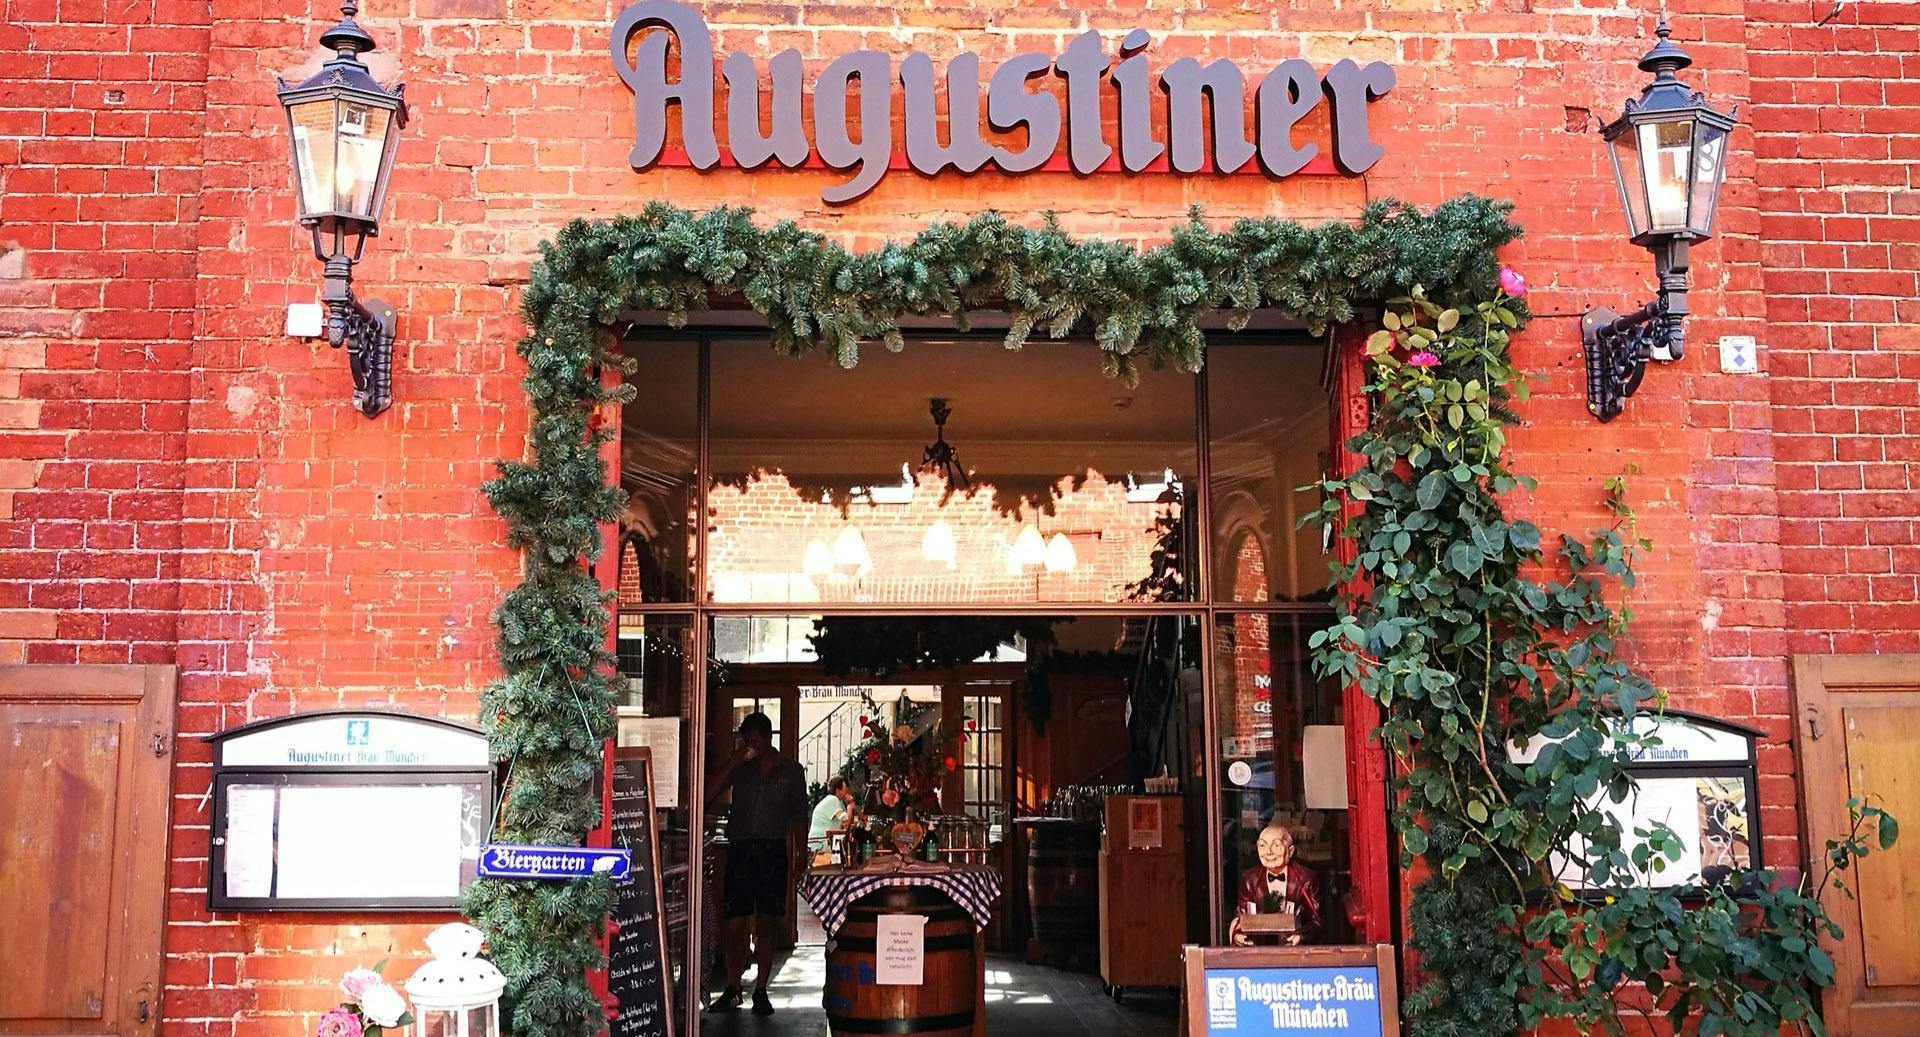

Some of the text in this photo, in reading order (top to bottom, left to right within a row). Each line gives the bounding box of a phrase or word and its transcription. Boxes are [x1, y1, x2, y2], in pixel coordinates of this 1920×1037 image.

[609, 0, 1397, 204] Augustiner
[287, 747, 351, 764] Augustiner
[1651, 746, 1689, 760] München
[491, 849, 586, 873] Biergarten
[1269, 1002, 1349, 1029] München
